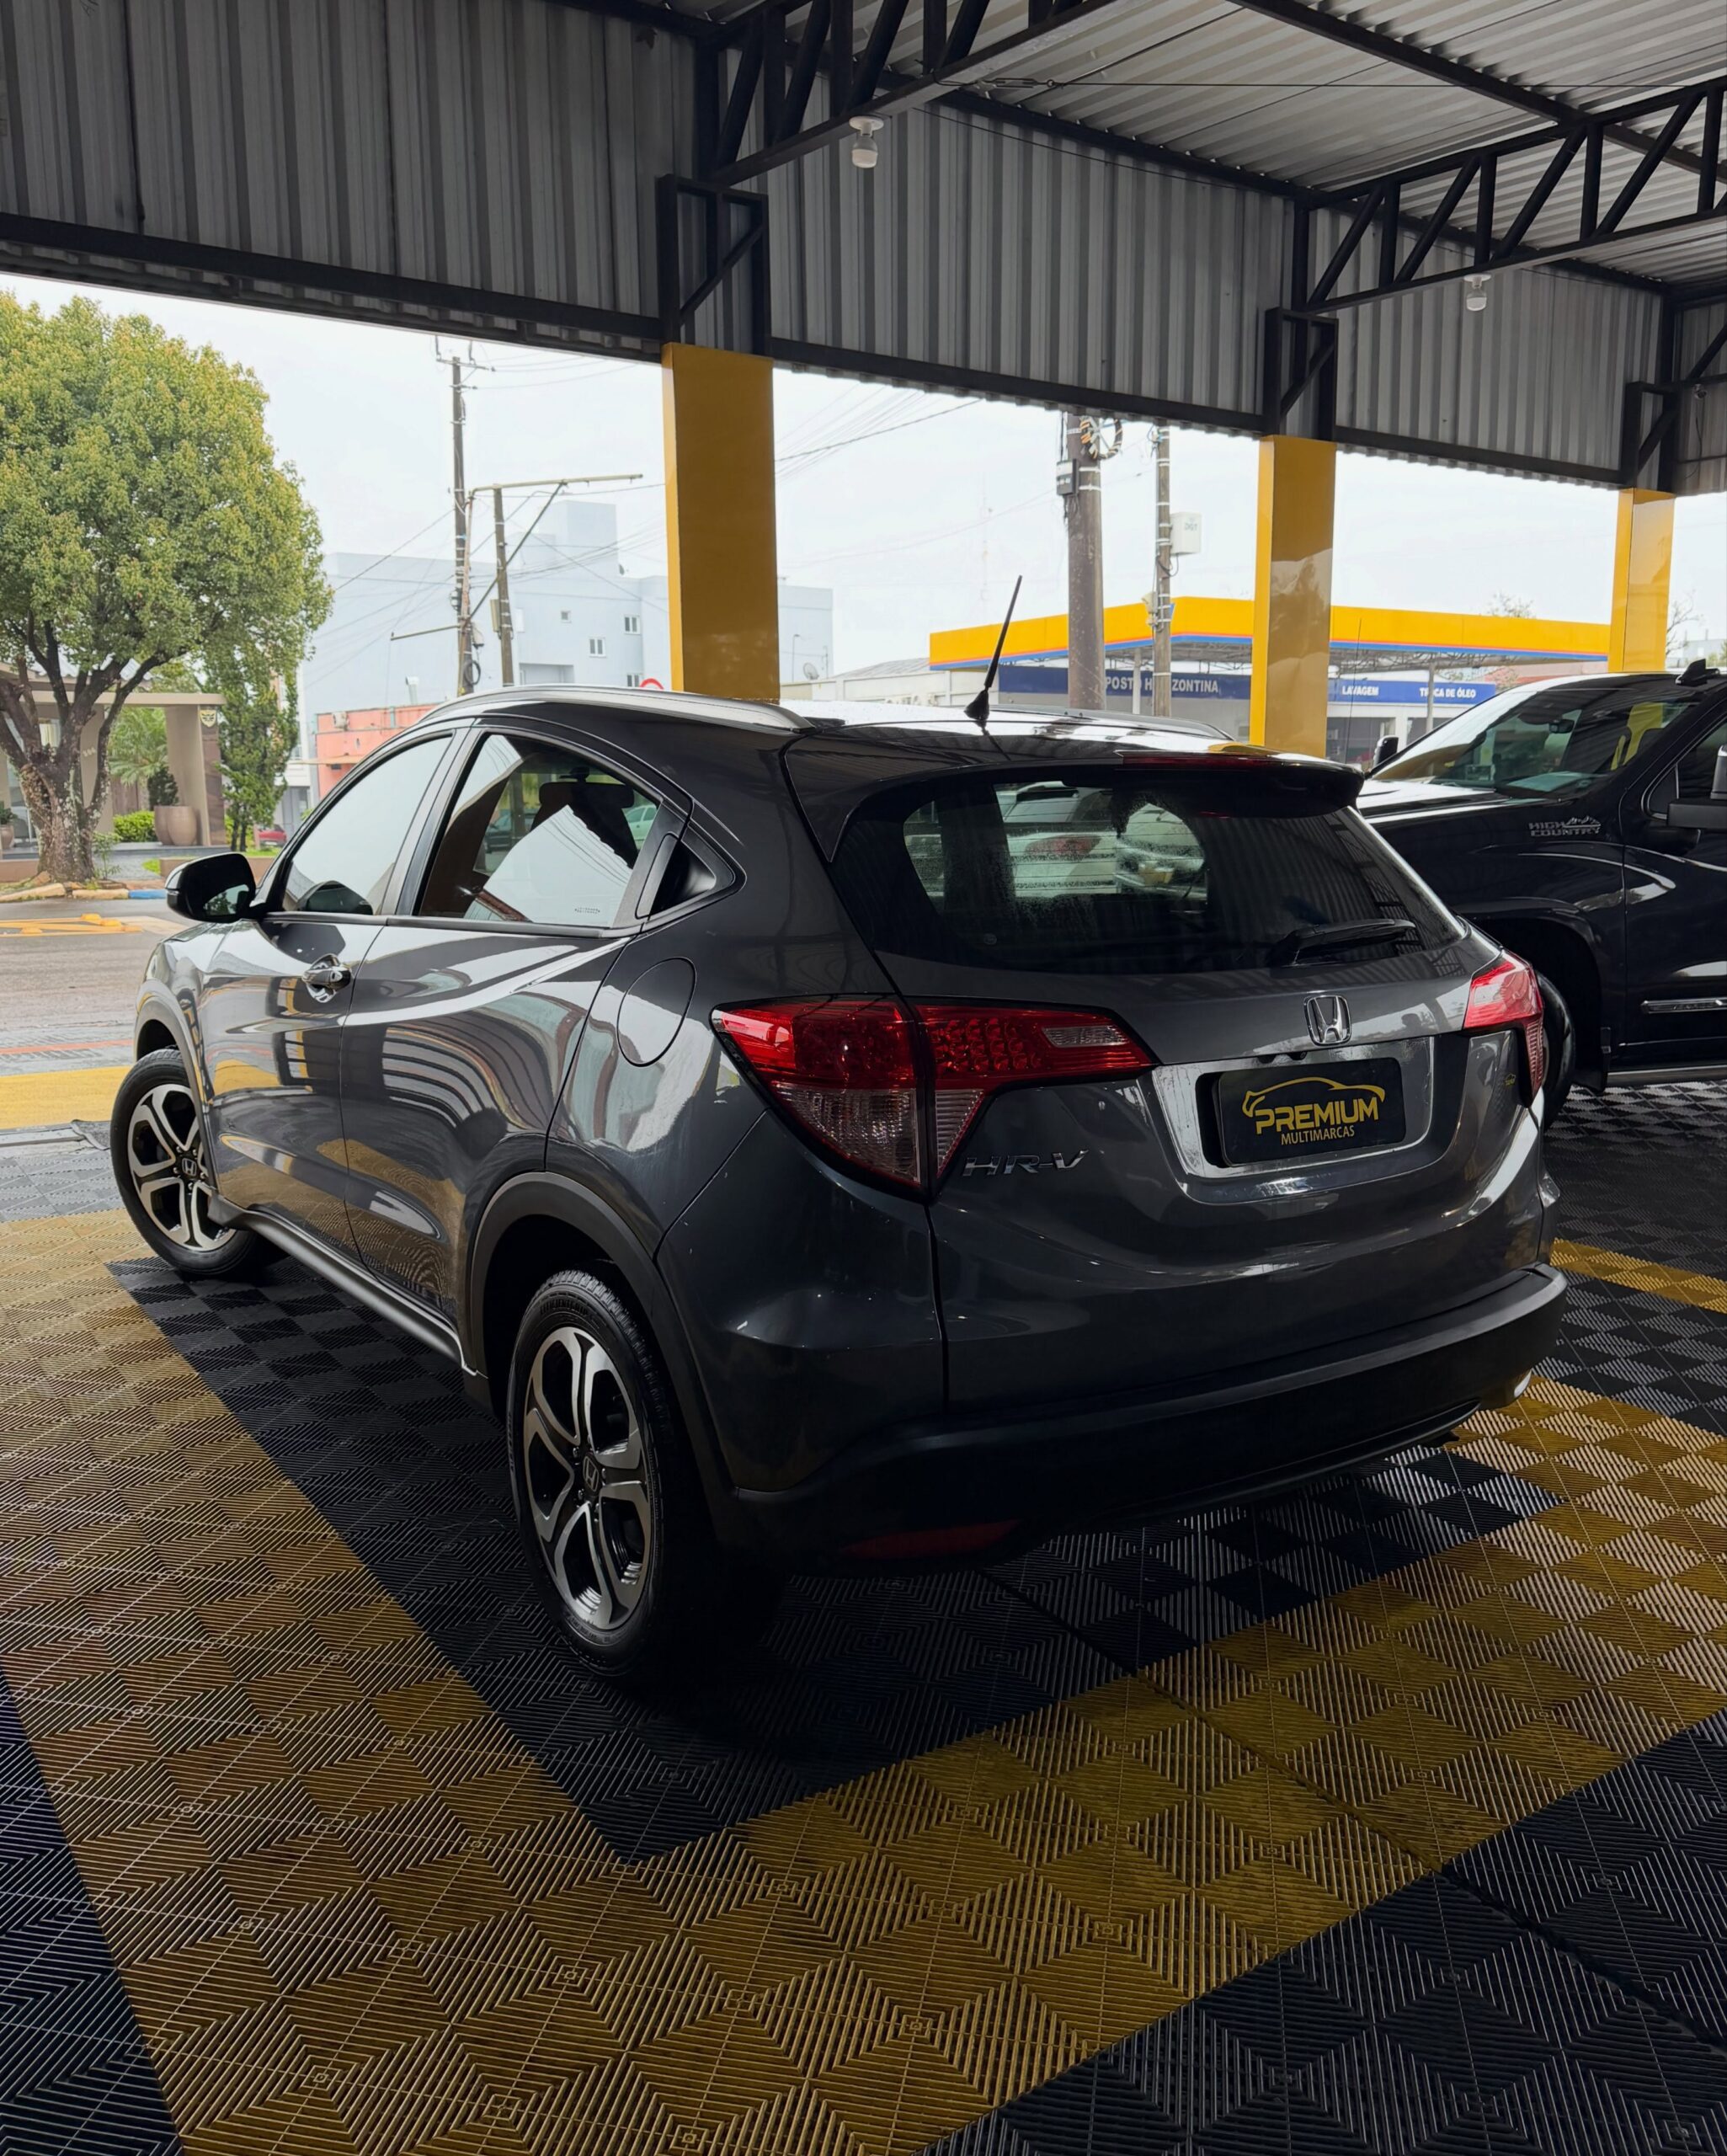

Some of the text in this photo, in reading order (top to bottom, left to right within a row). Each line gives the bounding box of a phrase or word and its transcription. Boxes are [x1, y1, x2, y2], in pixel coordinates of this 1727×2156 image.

[1105, 676, 1218, 693] POST HZONTINA
[1341, 685, 1379, 696] LAVAGEM
[1528, 821, 1564, 830] HIGH
[1530, 827, 1600, 836] COUNTRY
[1254, 1097, 1378, 1134] PREMIUM
[1281, 1125, 1355, 1145] MULTIMARCAS
[962, 1150, 1089, 1177] HR-V
